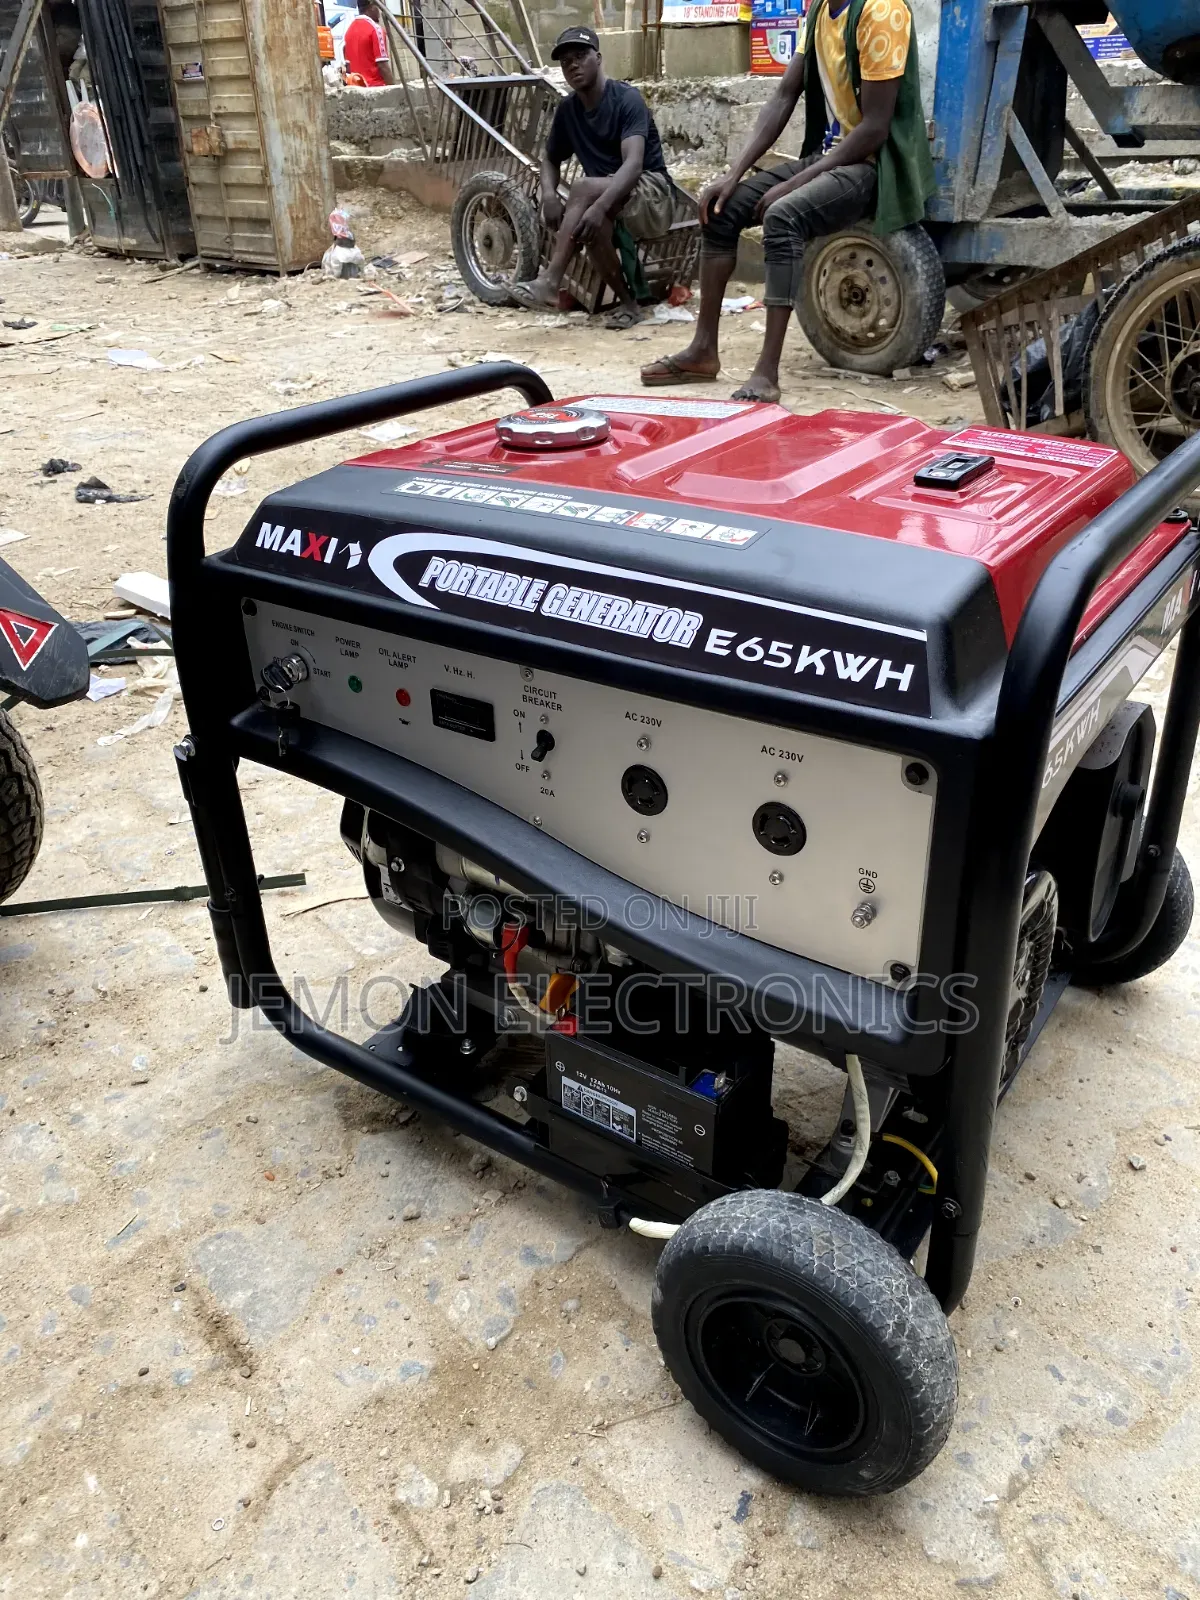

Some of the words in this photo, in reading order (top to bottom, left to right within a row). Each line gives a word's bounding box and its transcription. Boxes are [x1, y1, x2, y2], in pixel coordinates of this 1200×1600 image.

[694, 5, 725, 18] STANDING
[725, 5, 739, 18] FAN
[254, 522, 339, 565] MAXI
[271, 620, 293, 632] ENGINE
[293, 625, 315, 637] SWITCH
[418, 555, 549, 613] PORTABLE
[540, 582, 704, 649] GENERATOR
[704, 627, 916, 692] E65KWH
[290, 638, 299, 646] ON
[335, 636, 362, 649] POWER
[340, 648, 360, 659] LAMP
[378, 648, 391, 657] OIL
[392, 651, 417, 664] ALERT
[388, 659, 409, 670] LAMP
[313, 667, 331, 678] START
[523, 684, 558, 700] CIRCUIT
[522, 694, 563, 712] BREAKER
[513, 709, 526, 719] ON
[624, 711, 638, 722] AC
[639, 714, 662, 728] 230V
[761, 744, 776, 757] AC
[778, 748, 804, 763] 230V
[515, 763, 530, 773] OFF
[540, 786, 555, 798] 20A
[858, 867, 878, 879] GND
[575, 1071, 588, 1080] 12V
